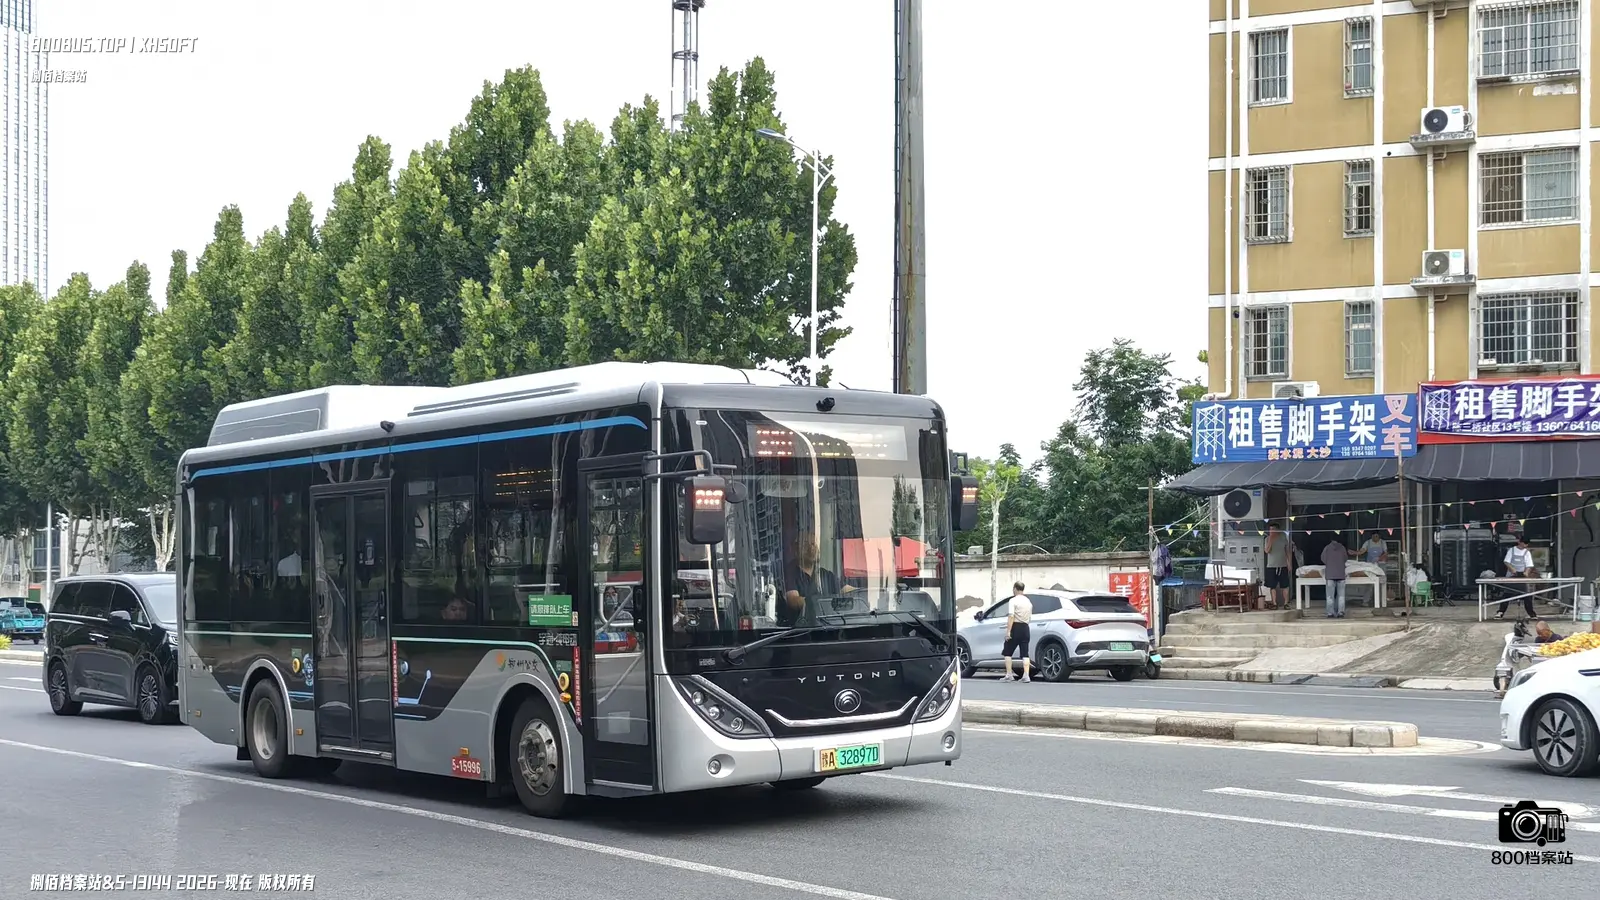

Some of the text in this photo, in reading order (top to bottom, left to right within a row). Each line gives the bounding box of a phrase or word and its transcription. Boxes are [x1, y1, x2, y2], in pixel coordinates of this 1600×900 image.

[1228, 400, 1377, 449] 租售脚手架
[1380, 395, 1413, 456] 叉车
[1536, 418, 1600, 432] 136076416
[798, 670, 897, 684] YUTONG
[452, 759, 481, 774] 5-15996
